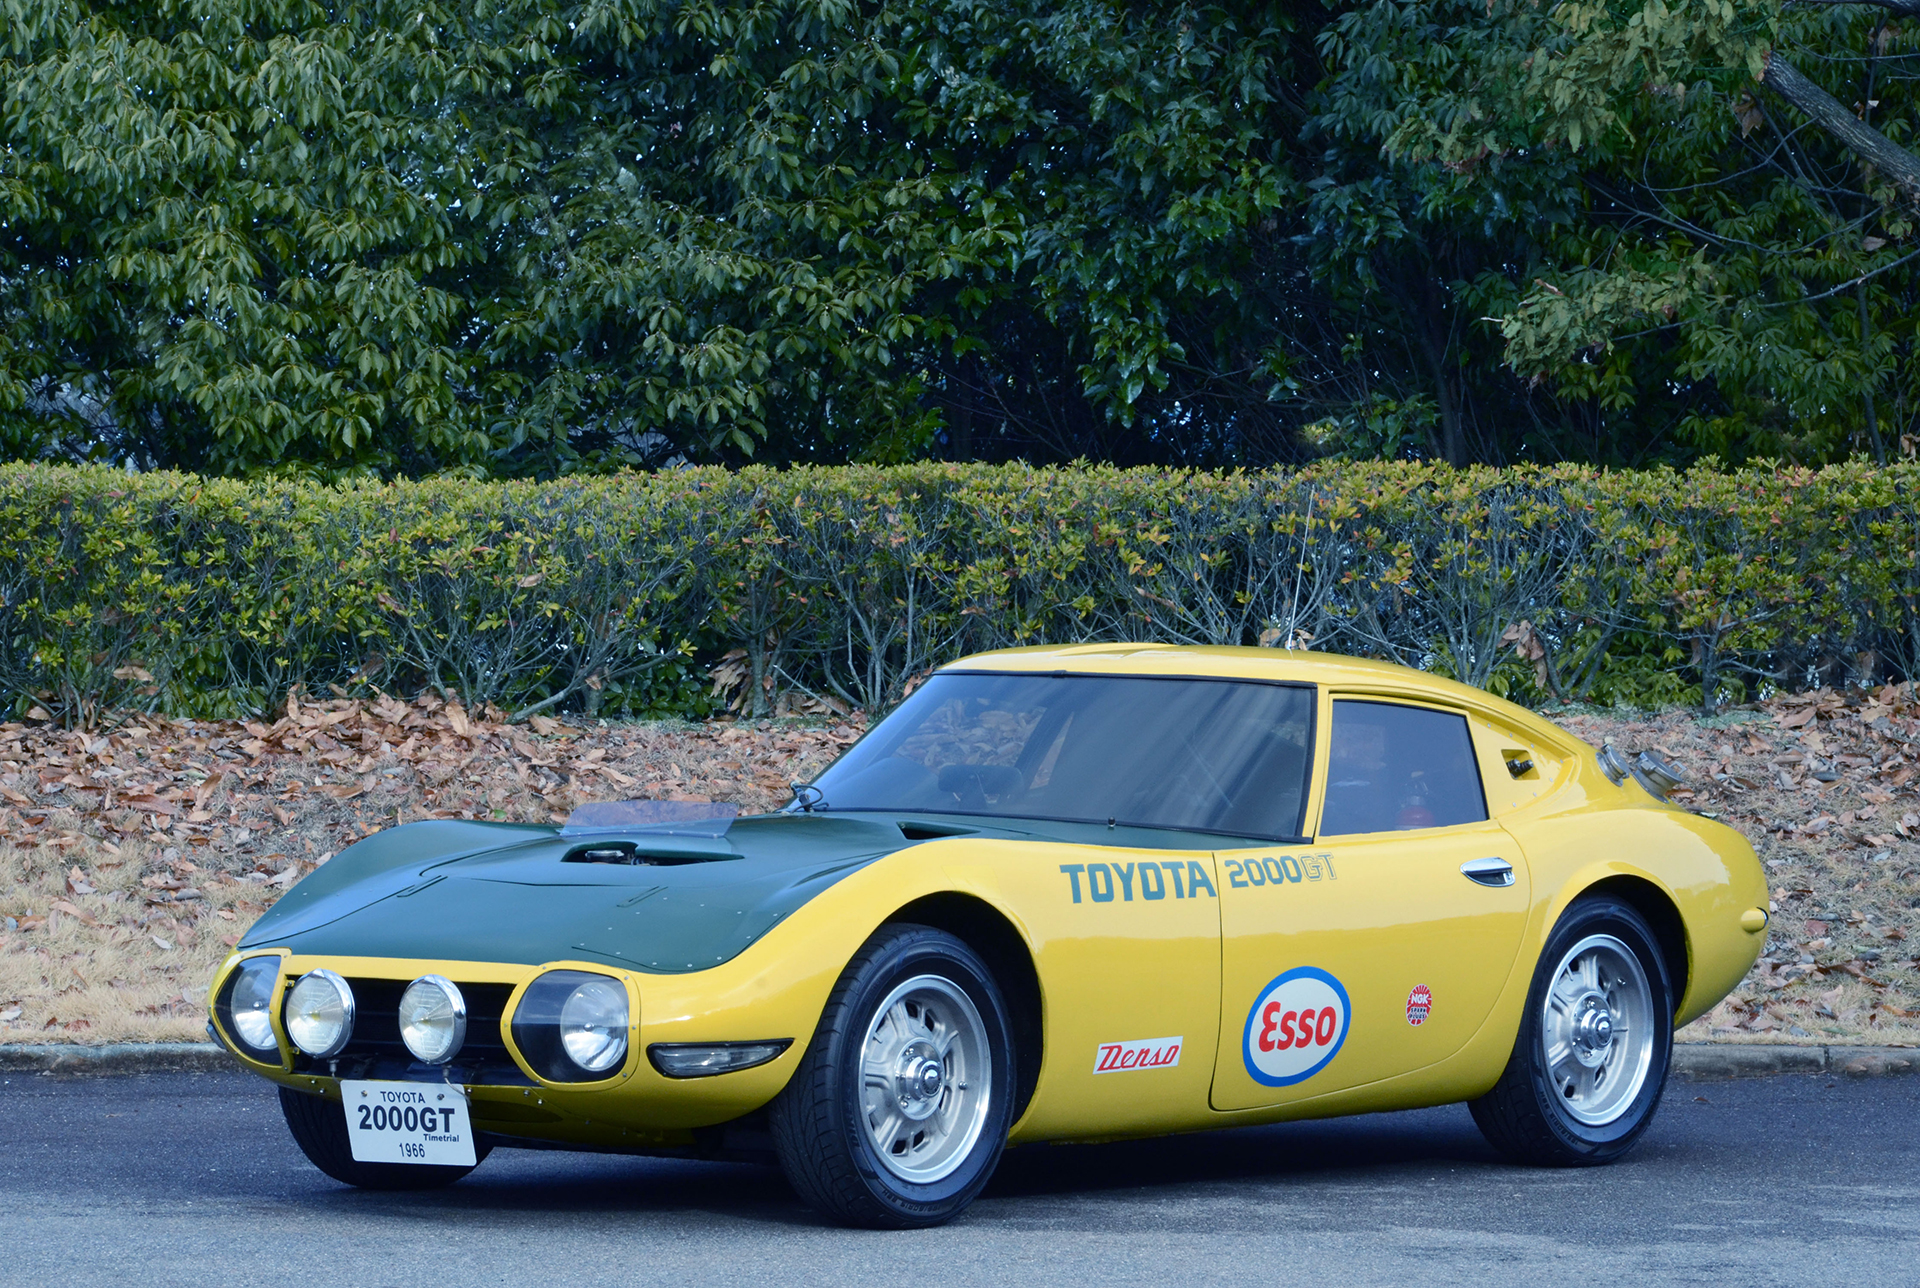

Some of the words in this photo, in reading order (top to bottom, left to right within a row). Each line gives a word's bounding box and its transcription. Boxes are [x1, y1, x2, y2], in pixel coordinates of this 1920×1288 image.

[1059, 861, 1217, 904] TOYOTA
[1224, 852, 1338, 889] 2000GT
[1410, 993, 1429, 1004] NGK
[1097, 1044, 1180, 1072] Denso
[380, 1091, 426, 1104] TOYOTA
[357, 1104, 455, 1133] 2000GT
[423, 1133, 459, 1142] Timetrial
[399, 1142, 426, 1158] 1966
